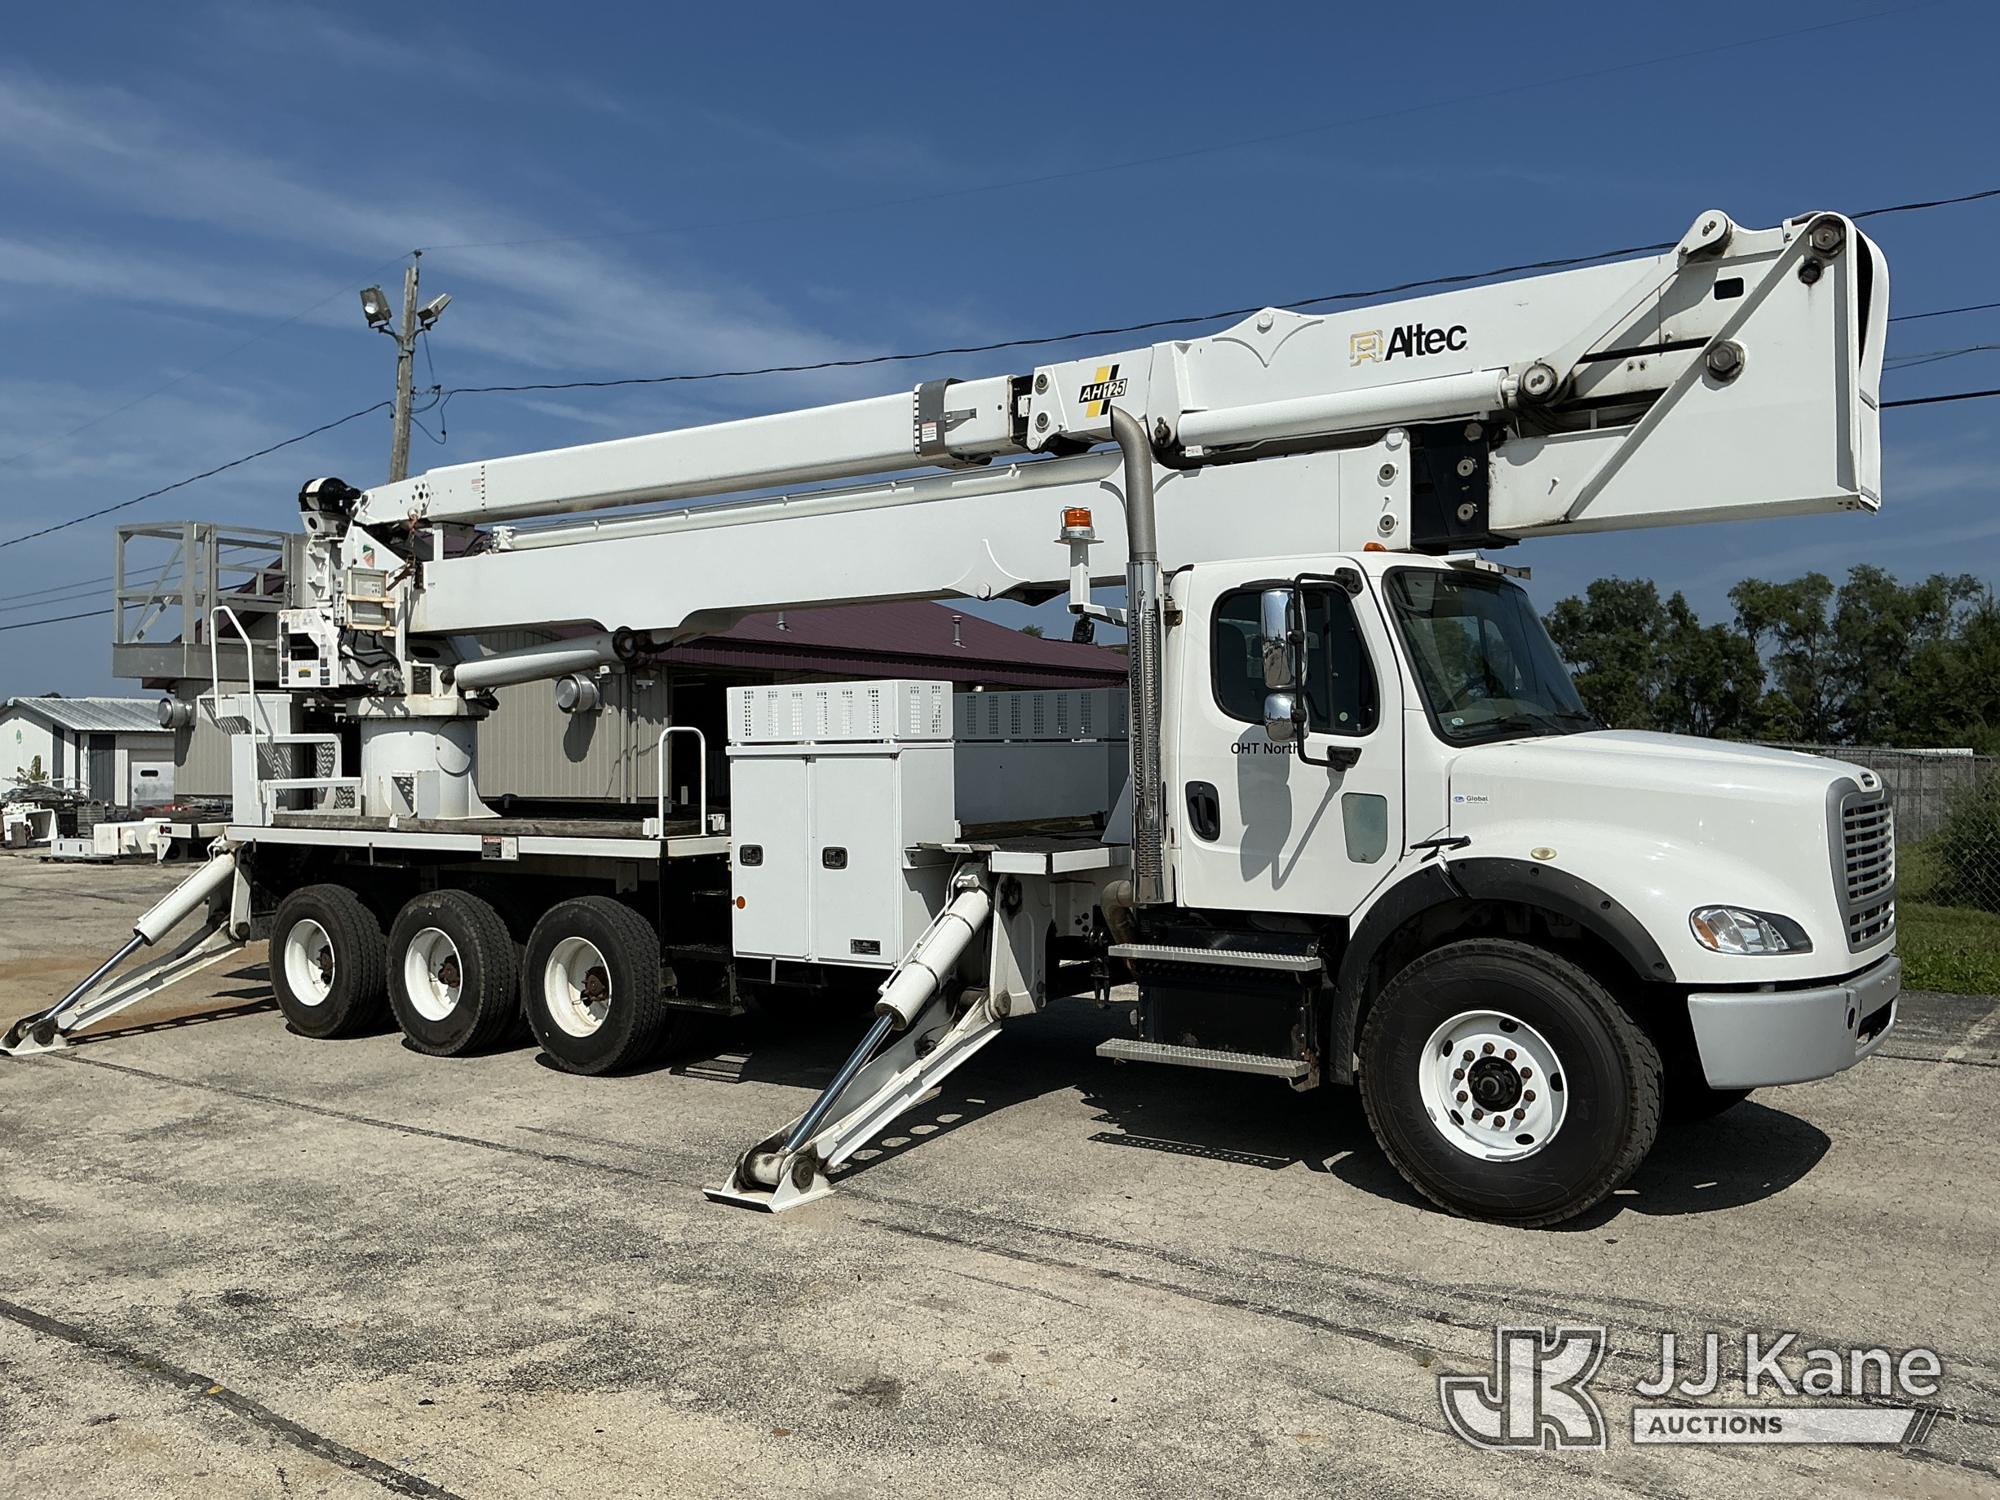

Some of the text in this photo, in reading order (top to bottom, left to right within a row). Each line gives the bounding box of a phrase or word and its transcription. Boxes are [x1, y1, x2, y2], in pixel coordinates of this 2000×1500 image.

[1384, 322, 1468, 362] Altec
[1080, 381, 1125, 401] AH125
[1230, 742, 1260, 755] OHT
